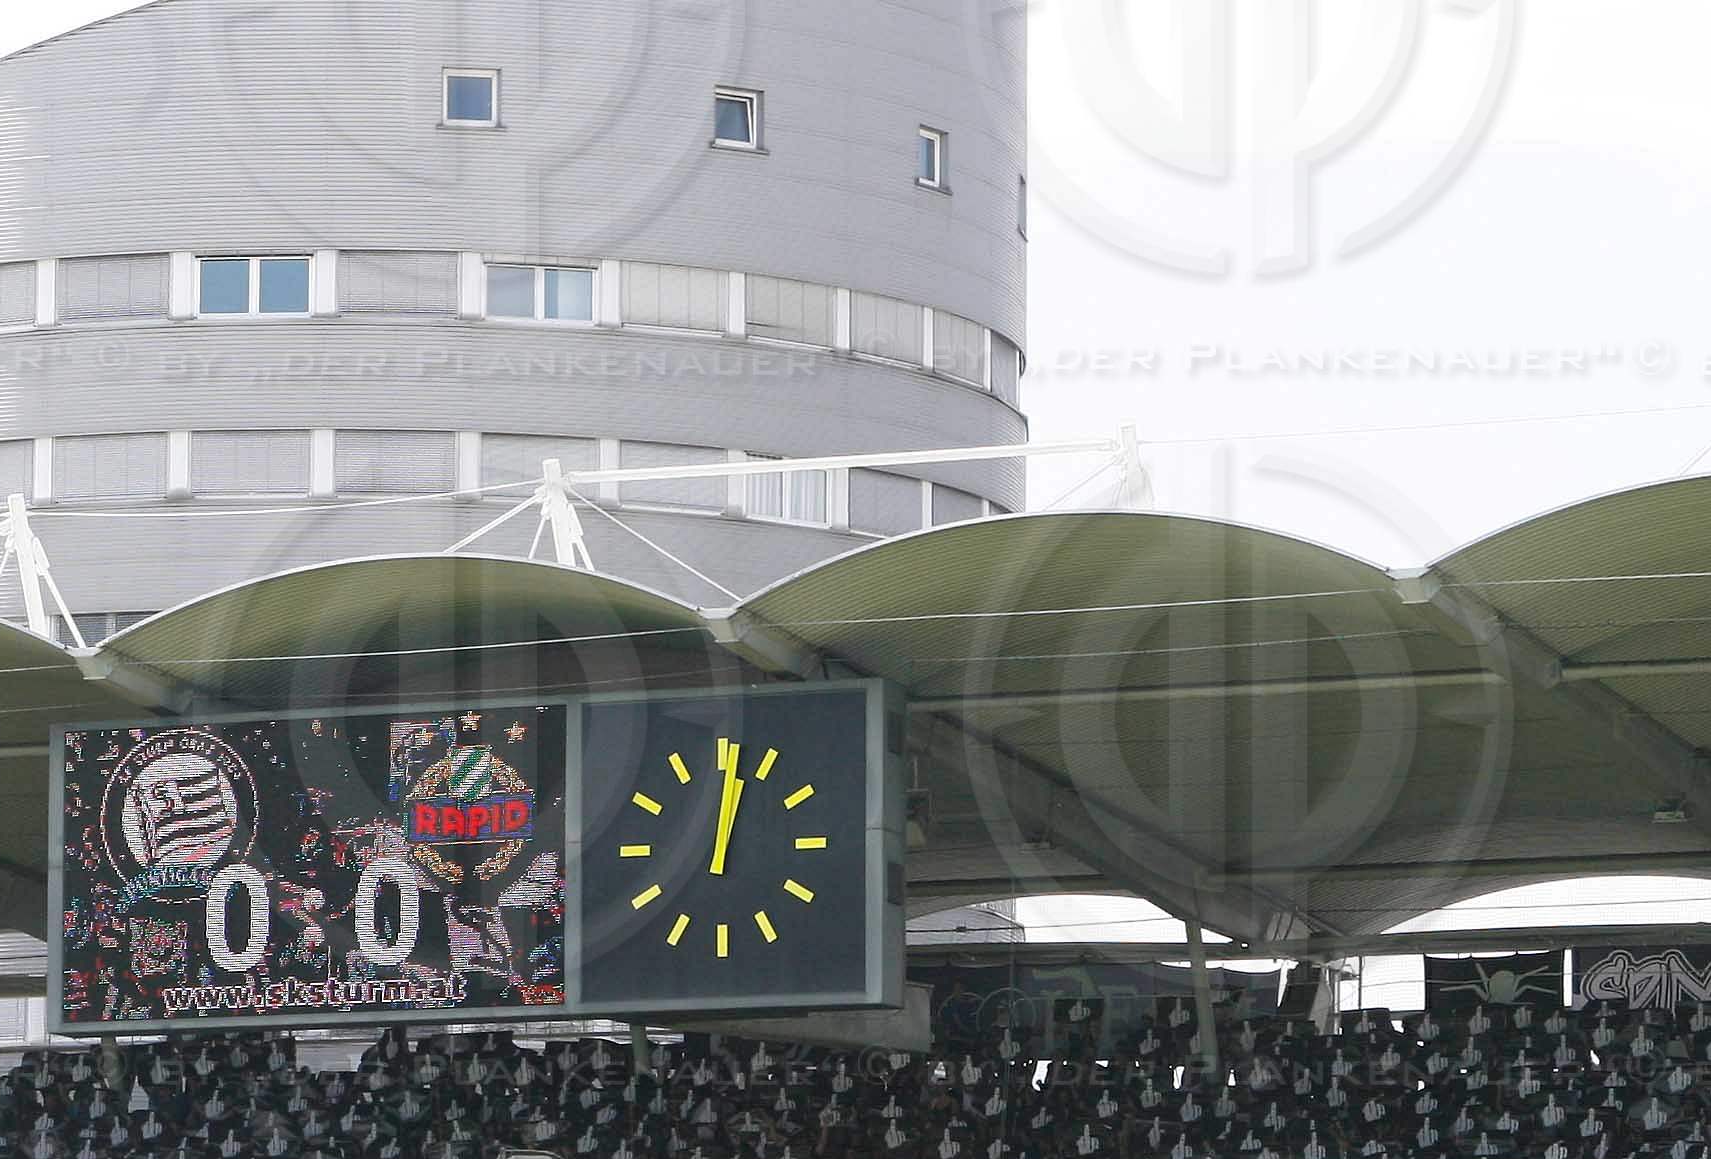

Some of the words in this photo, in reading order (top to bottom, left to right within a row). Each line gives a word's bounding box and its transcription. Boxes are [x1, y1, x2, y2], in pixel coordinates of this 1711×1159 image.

[413, 800, 531, 838] RAPID
[205, 862, 271, 973] 0
[354, 857, 420, 967] 0
[162, 973, 467, 1011] www.sksturm.at
